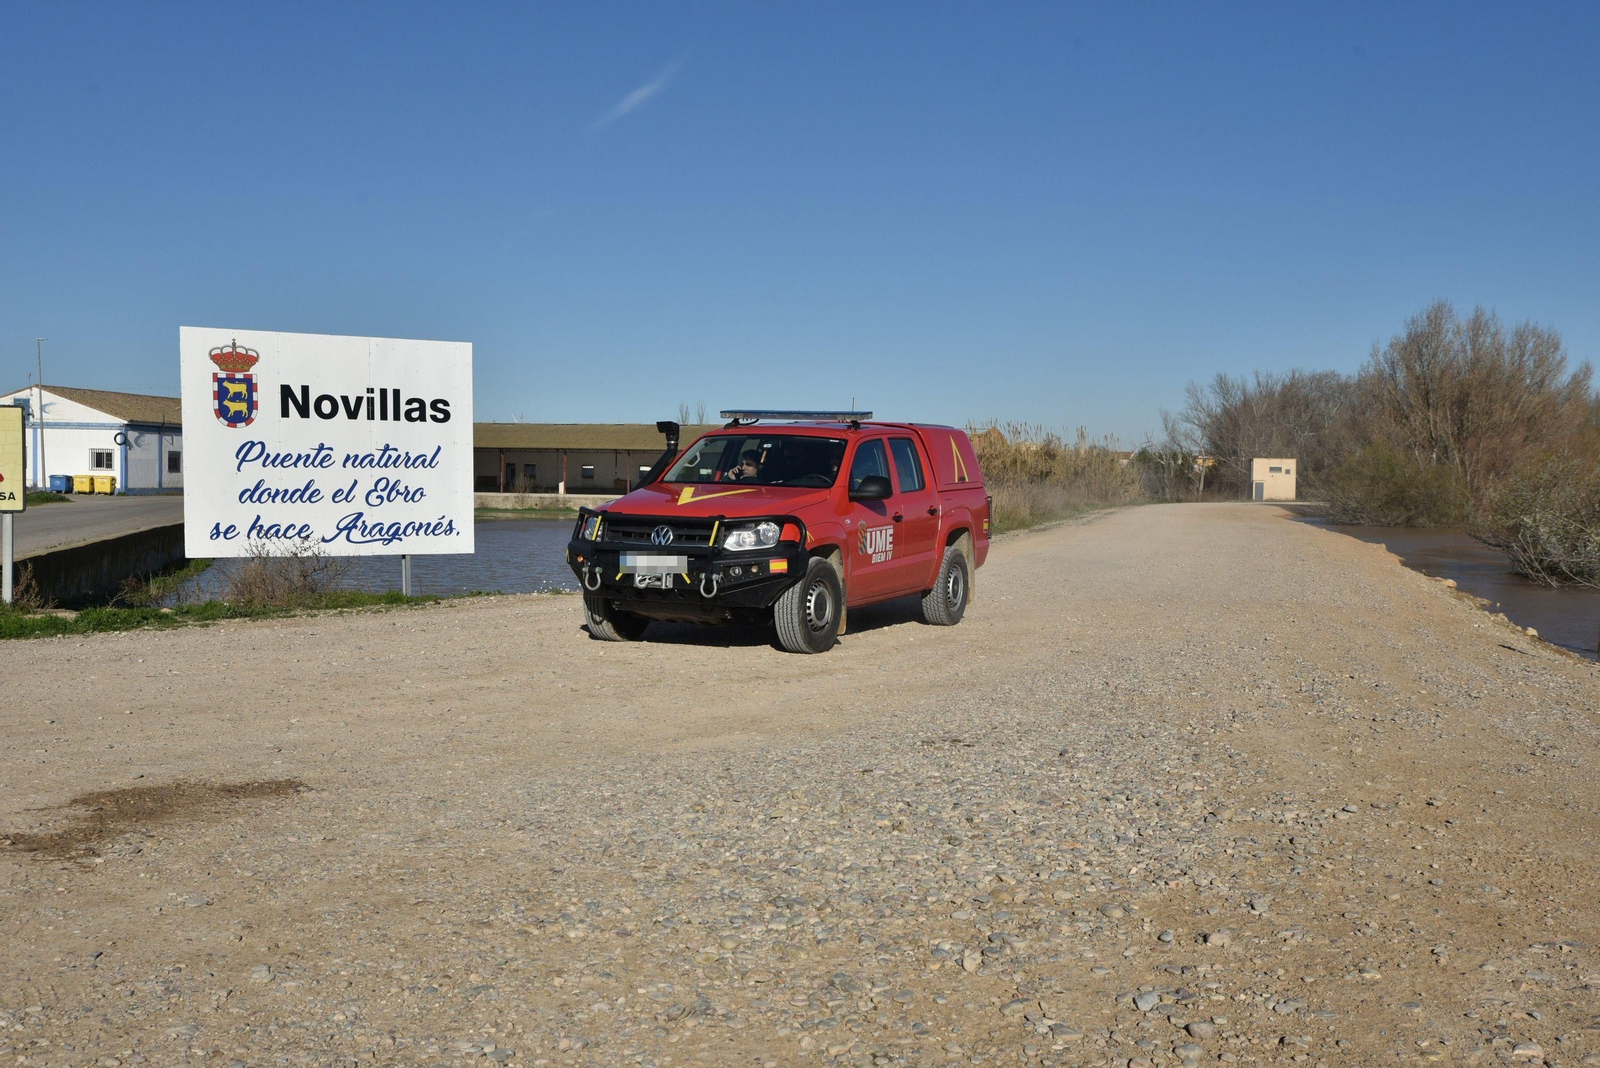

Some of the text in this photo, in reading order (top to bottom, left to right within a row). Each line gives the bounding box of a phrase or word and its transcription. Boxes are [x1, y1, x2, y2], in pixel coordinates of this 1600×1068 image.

[280, 384, 451, 423] Novillas
[235, 440, 441, 472] Puente natural
[238, 477, 426, 507] donde el Ebro
[210, 512, 461, 546] se hace Aragonés.
[866, 528, 893, 554] UME
